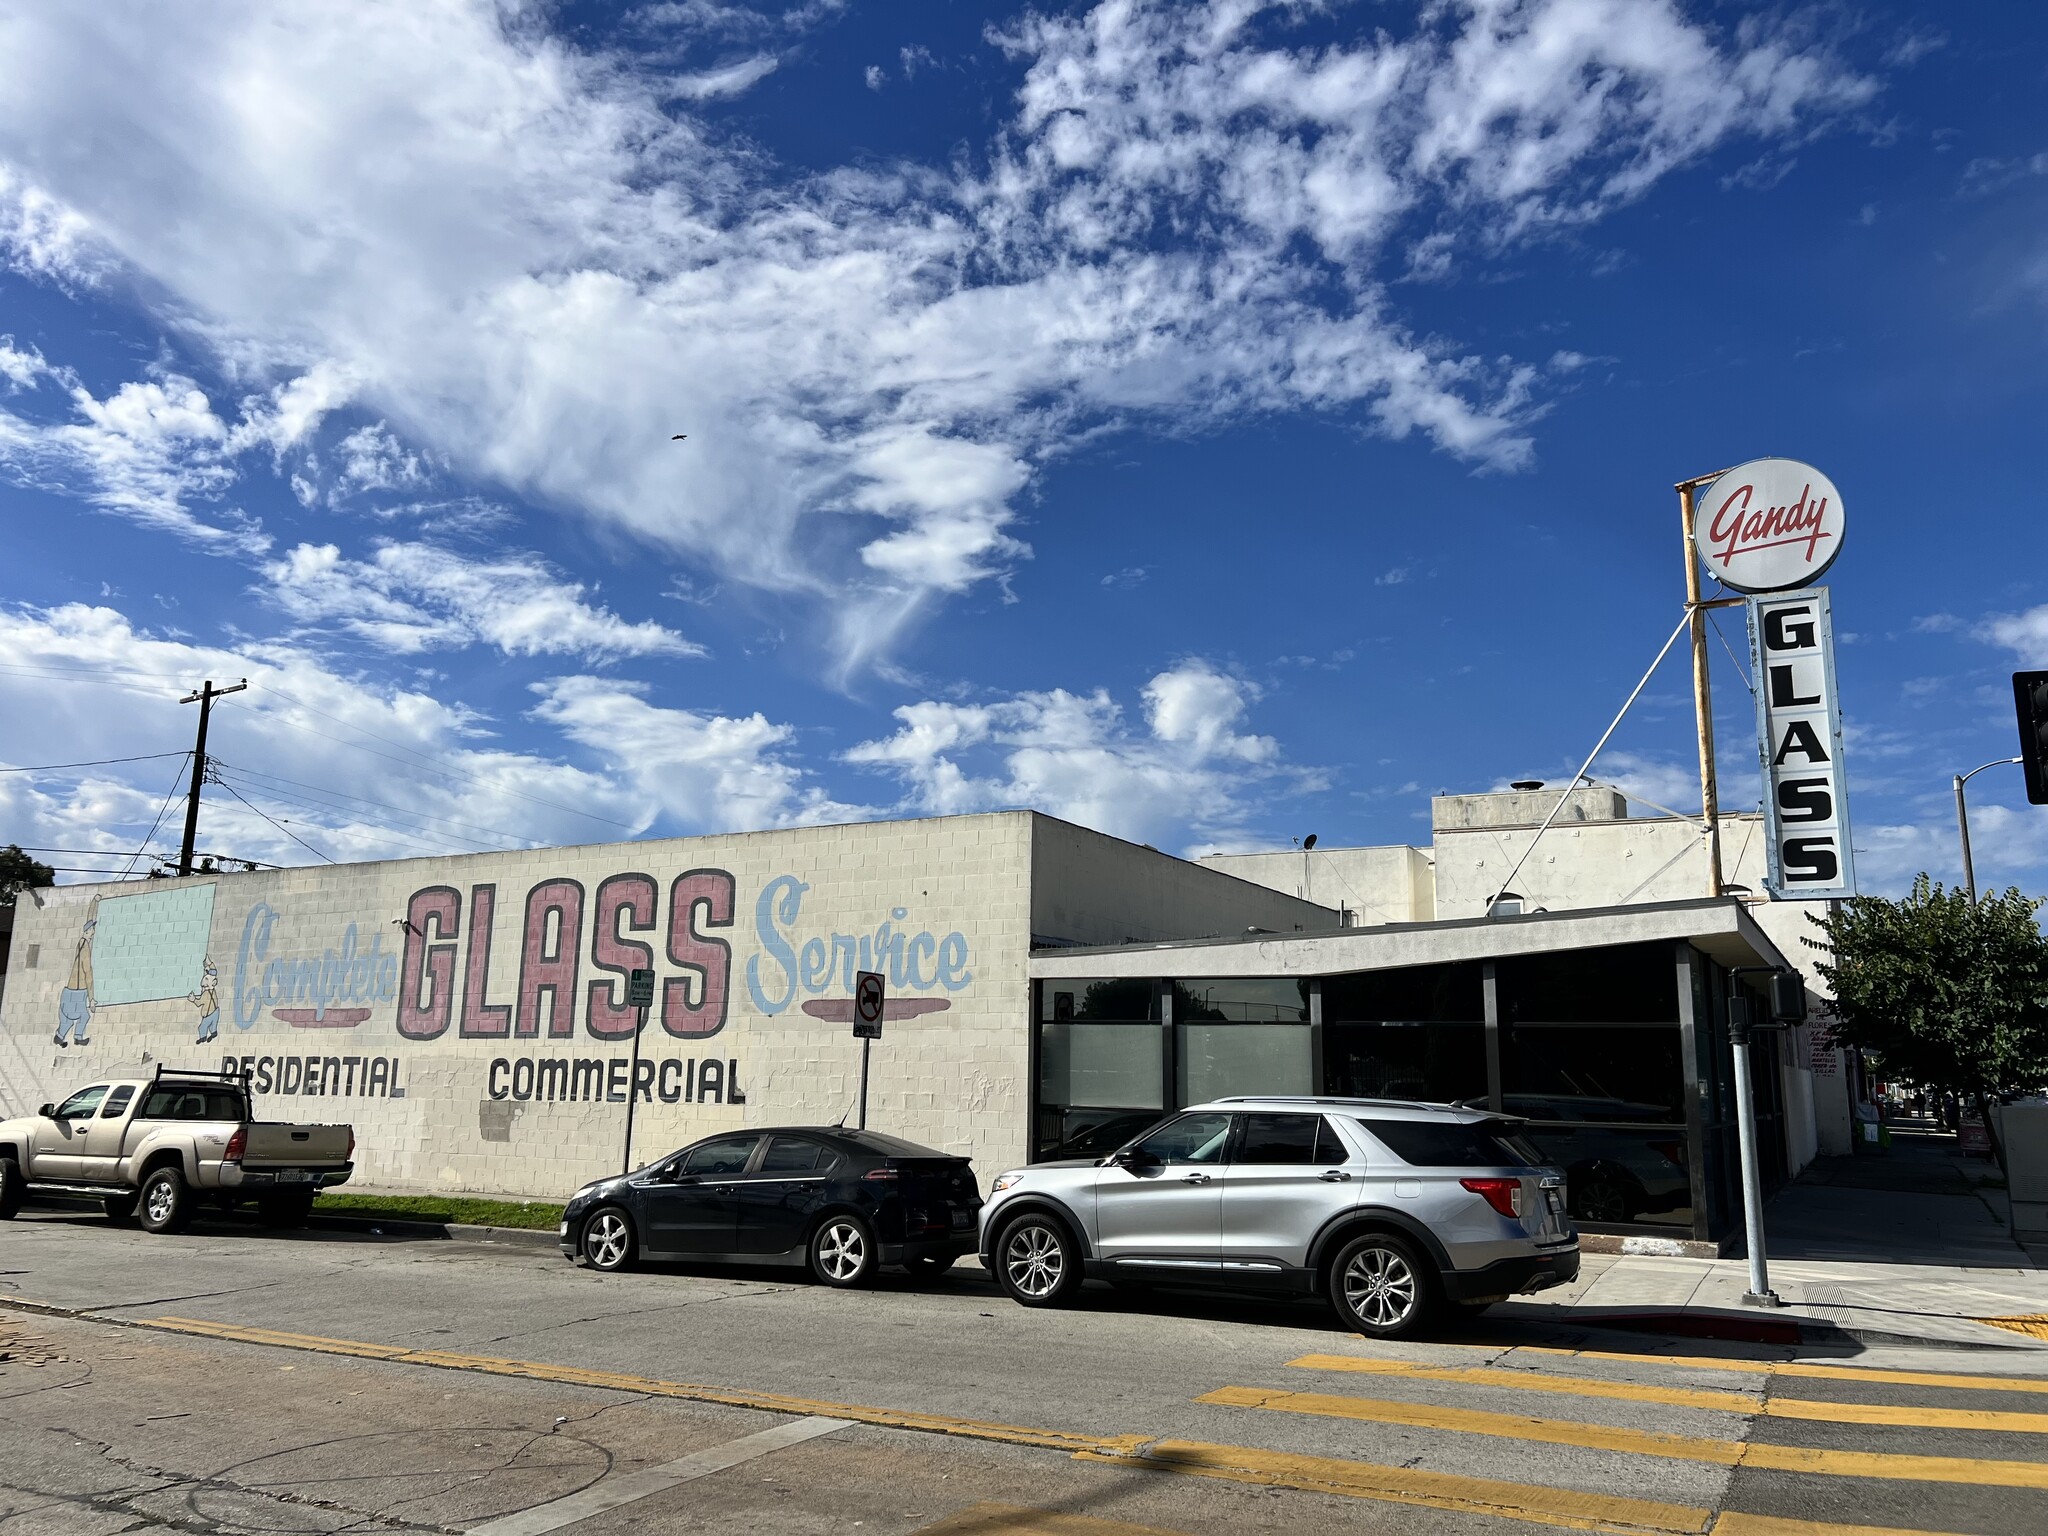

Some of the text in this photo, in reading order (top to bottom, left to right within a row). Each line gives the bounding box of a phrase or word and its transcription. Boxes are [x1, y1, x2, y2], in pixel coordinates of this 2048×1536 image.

[1710, 484, 1829, 567] Gandy
[1763, 606, 1838, 882] GLASS
[233, 868, 973, 1040] Complete GLASS Service
[488, 1057, 745, 1104] COMMERCIAL
